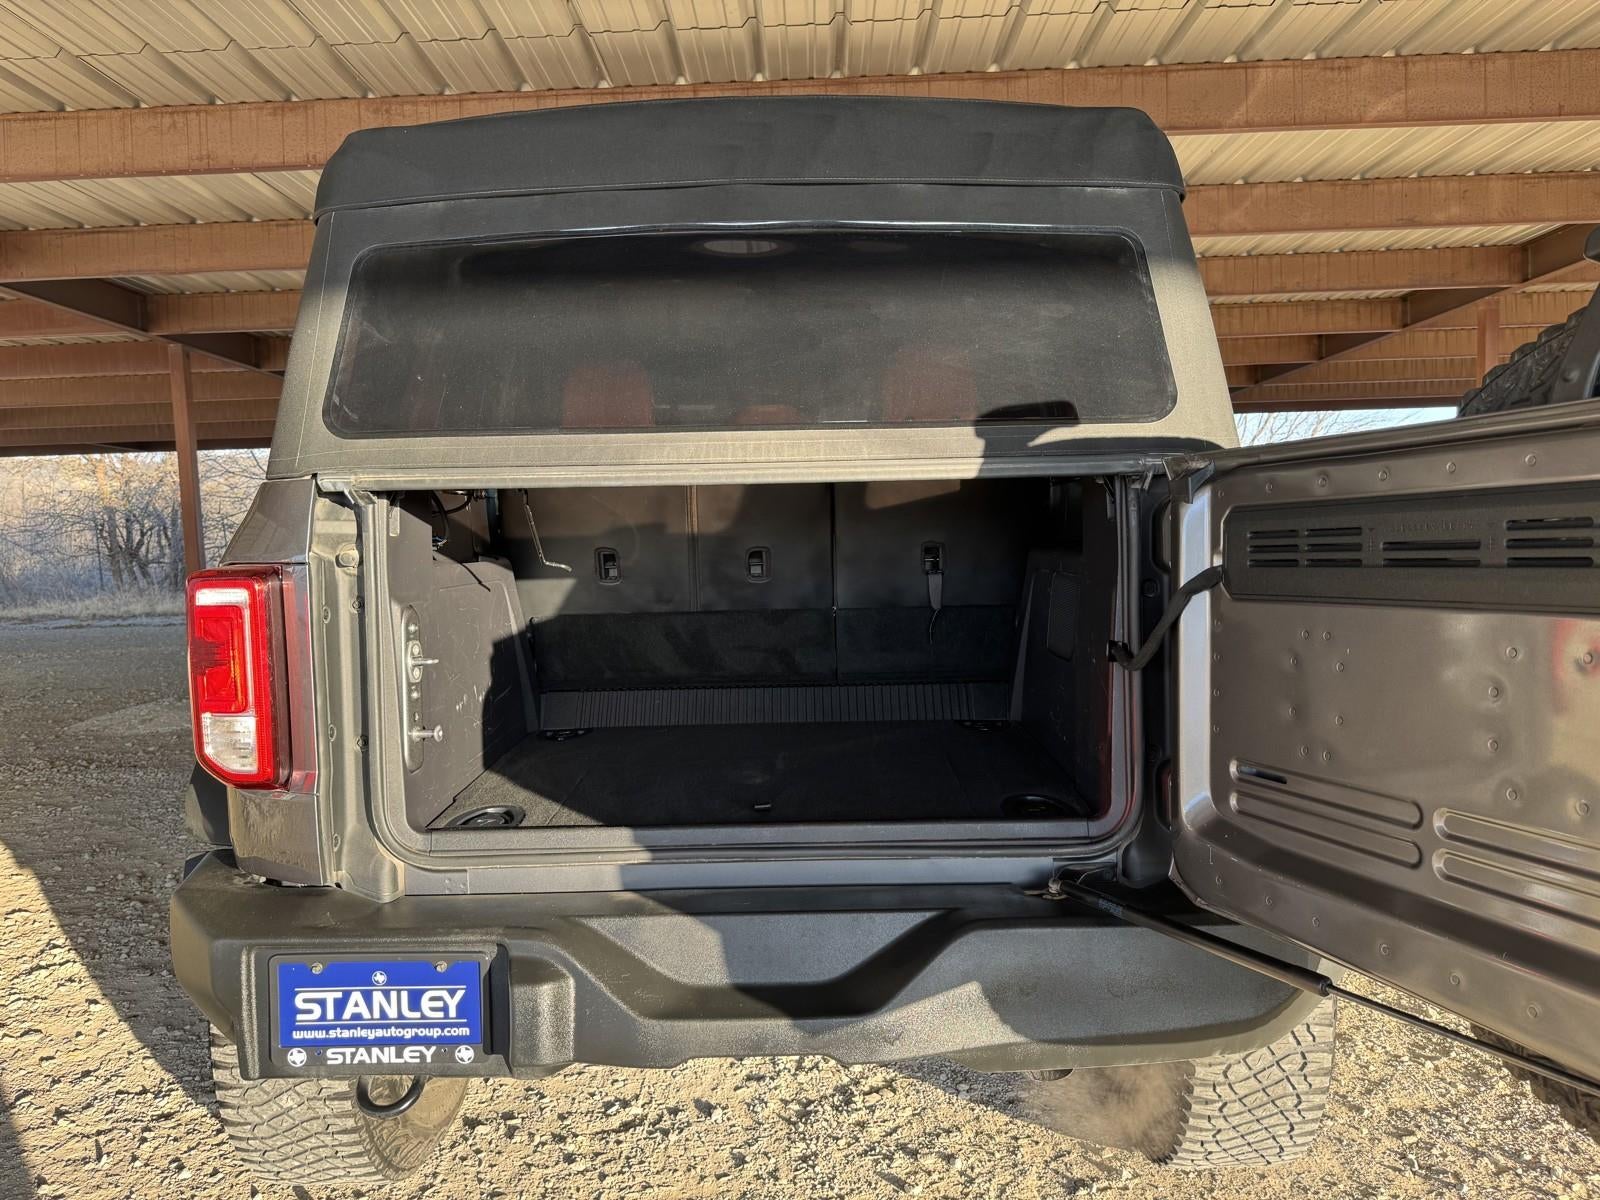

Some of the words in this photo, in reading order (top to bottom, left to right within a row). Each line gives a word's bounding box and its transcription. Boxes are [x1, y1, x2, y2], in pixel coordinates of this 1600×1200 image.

[294, 990, 466, 1021] STANLEY
[292, 1027, 470, 1040] www.stanleyautogroup.com
[326, 1046, 437, 1065] STANLEY
